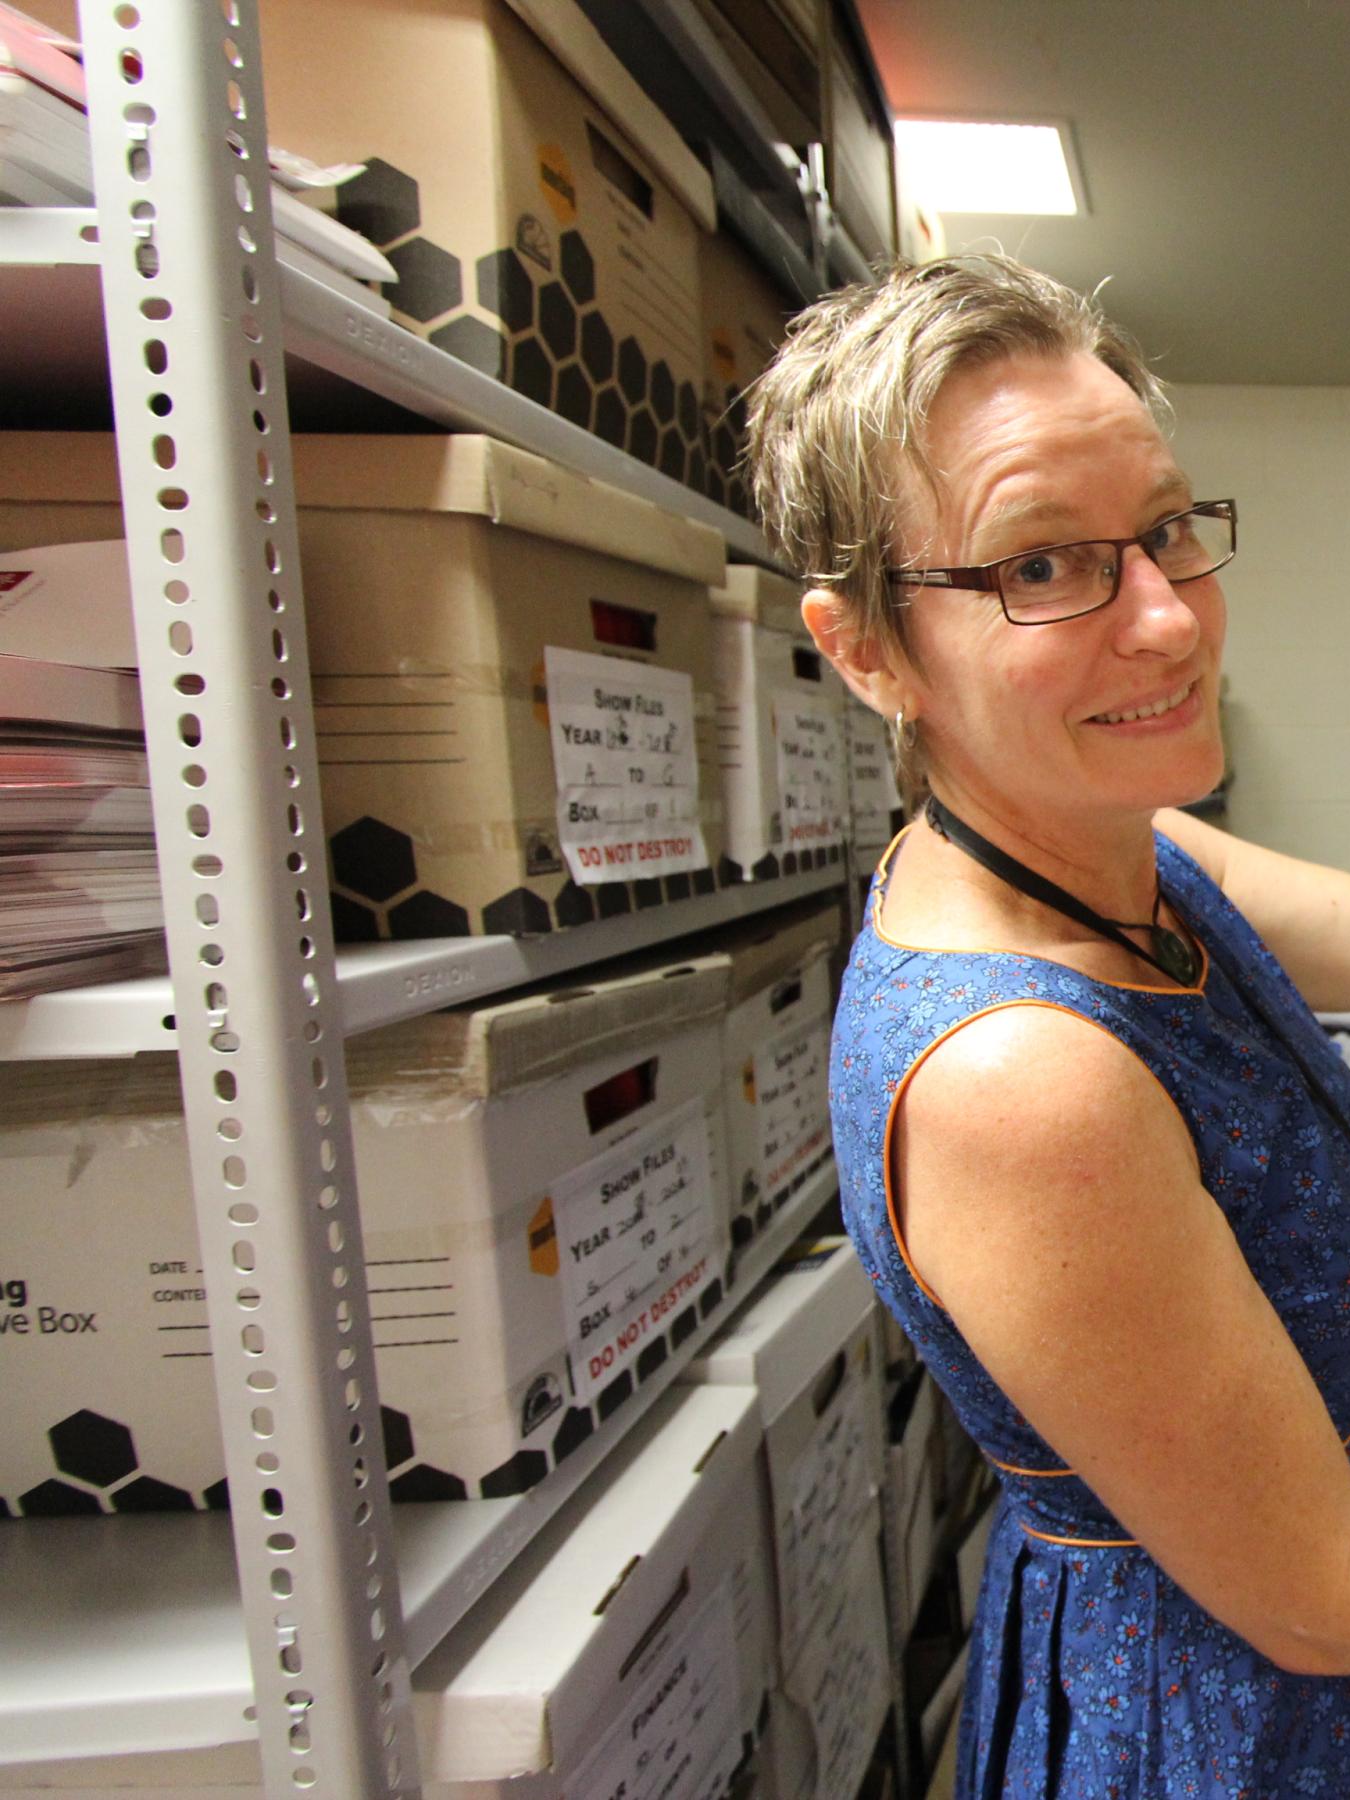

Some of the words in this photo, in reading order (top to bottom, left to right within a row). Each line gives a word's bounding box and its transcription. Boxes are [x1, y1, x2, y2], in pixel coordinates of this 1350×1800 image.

[594, 688, 632, 713] SHOW
[561, 723, 602, 746] YEAR
[629, 766, 644, 783] TO
[577, 846, 603, 868] DO
[604, 843, 633, 865] NOT
[637, 837, 693, 861] DESTROY
[601, 1167, 641, 1204] SHOW
[642, 1144, 676, 1174] FILES
[570, 1226, 611, 1263] YEAR
[641, 1229, 656, 1250] TO
[150, 1261, 188, 1275] DATE
[38, 1306, 99, 1334] Box
[588, 1346, 616, 1381] DO
[617, 1311, 649, 1352] NOT
[650, 1257, 709, 1325] DESTROY
